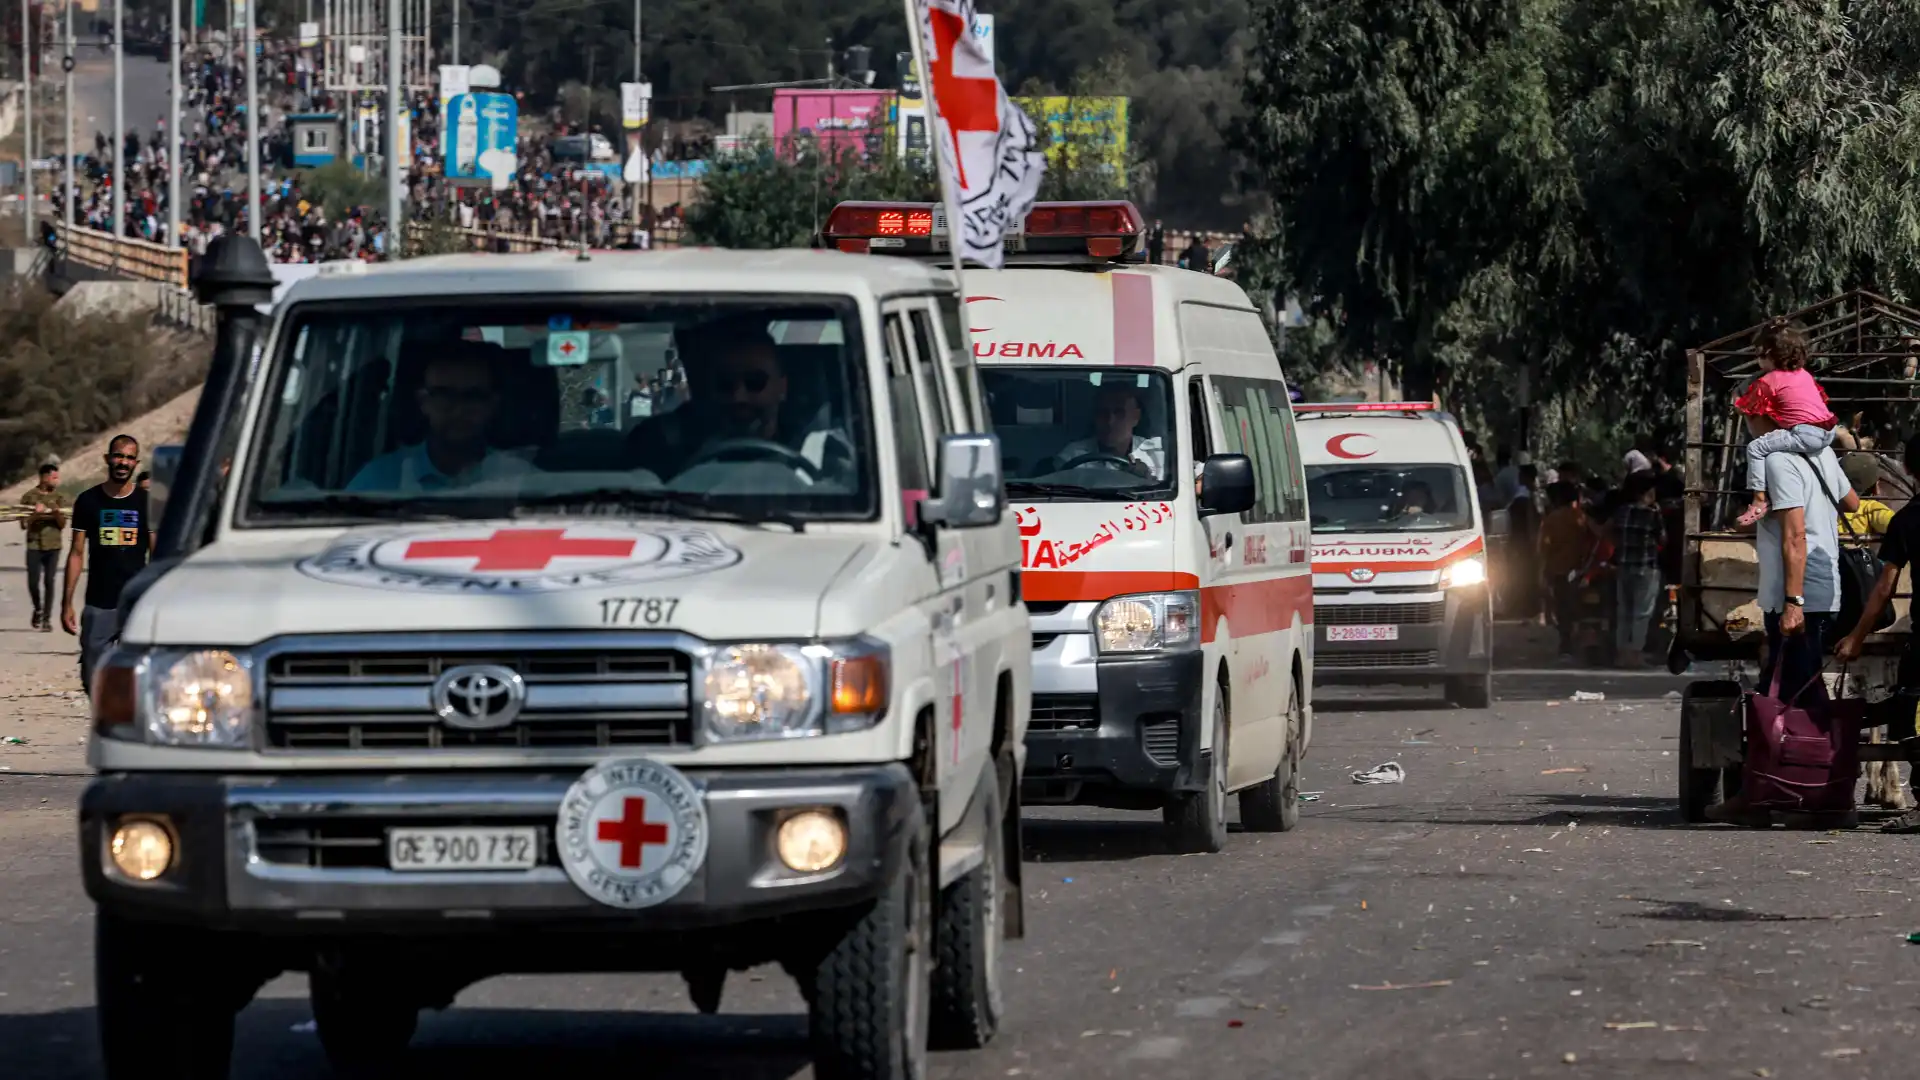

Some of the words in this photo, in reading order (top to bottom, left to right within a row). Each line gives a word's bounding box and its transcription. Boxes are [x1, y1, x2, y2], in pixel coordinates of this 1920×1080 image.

[600, 598, 680, 624] 17787
[434, 836, 479, 862] 900
[488, 836, 529, 862] 732
